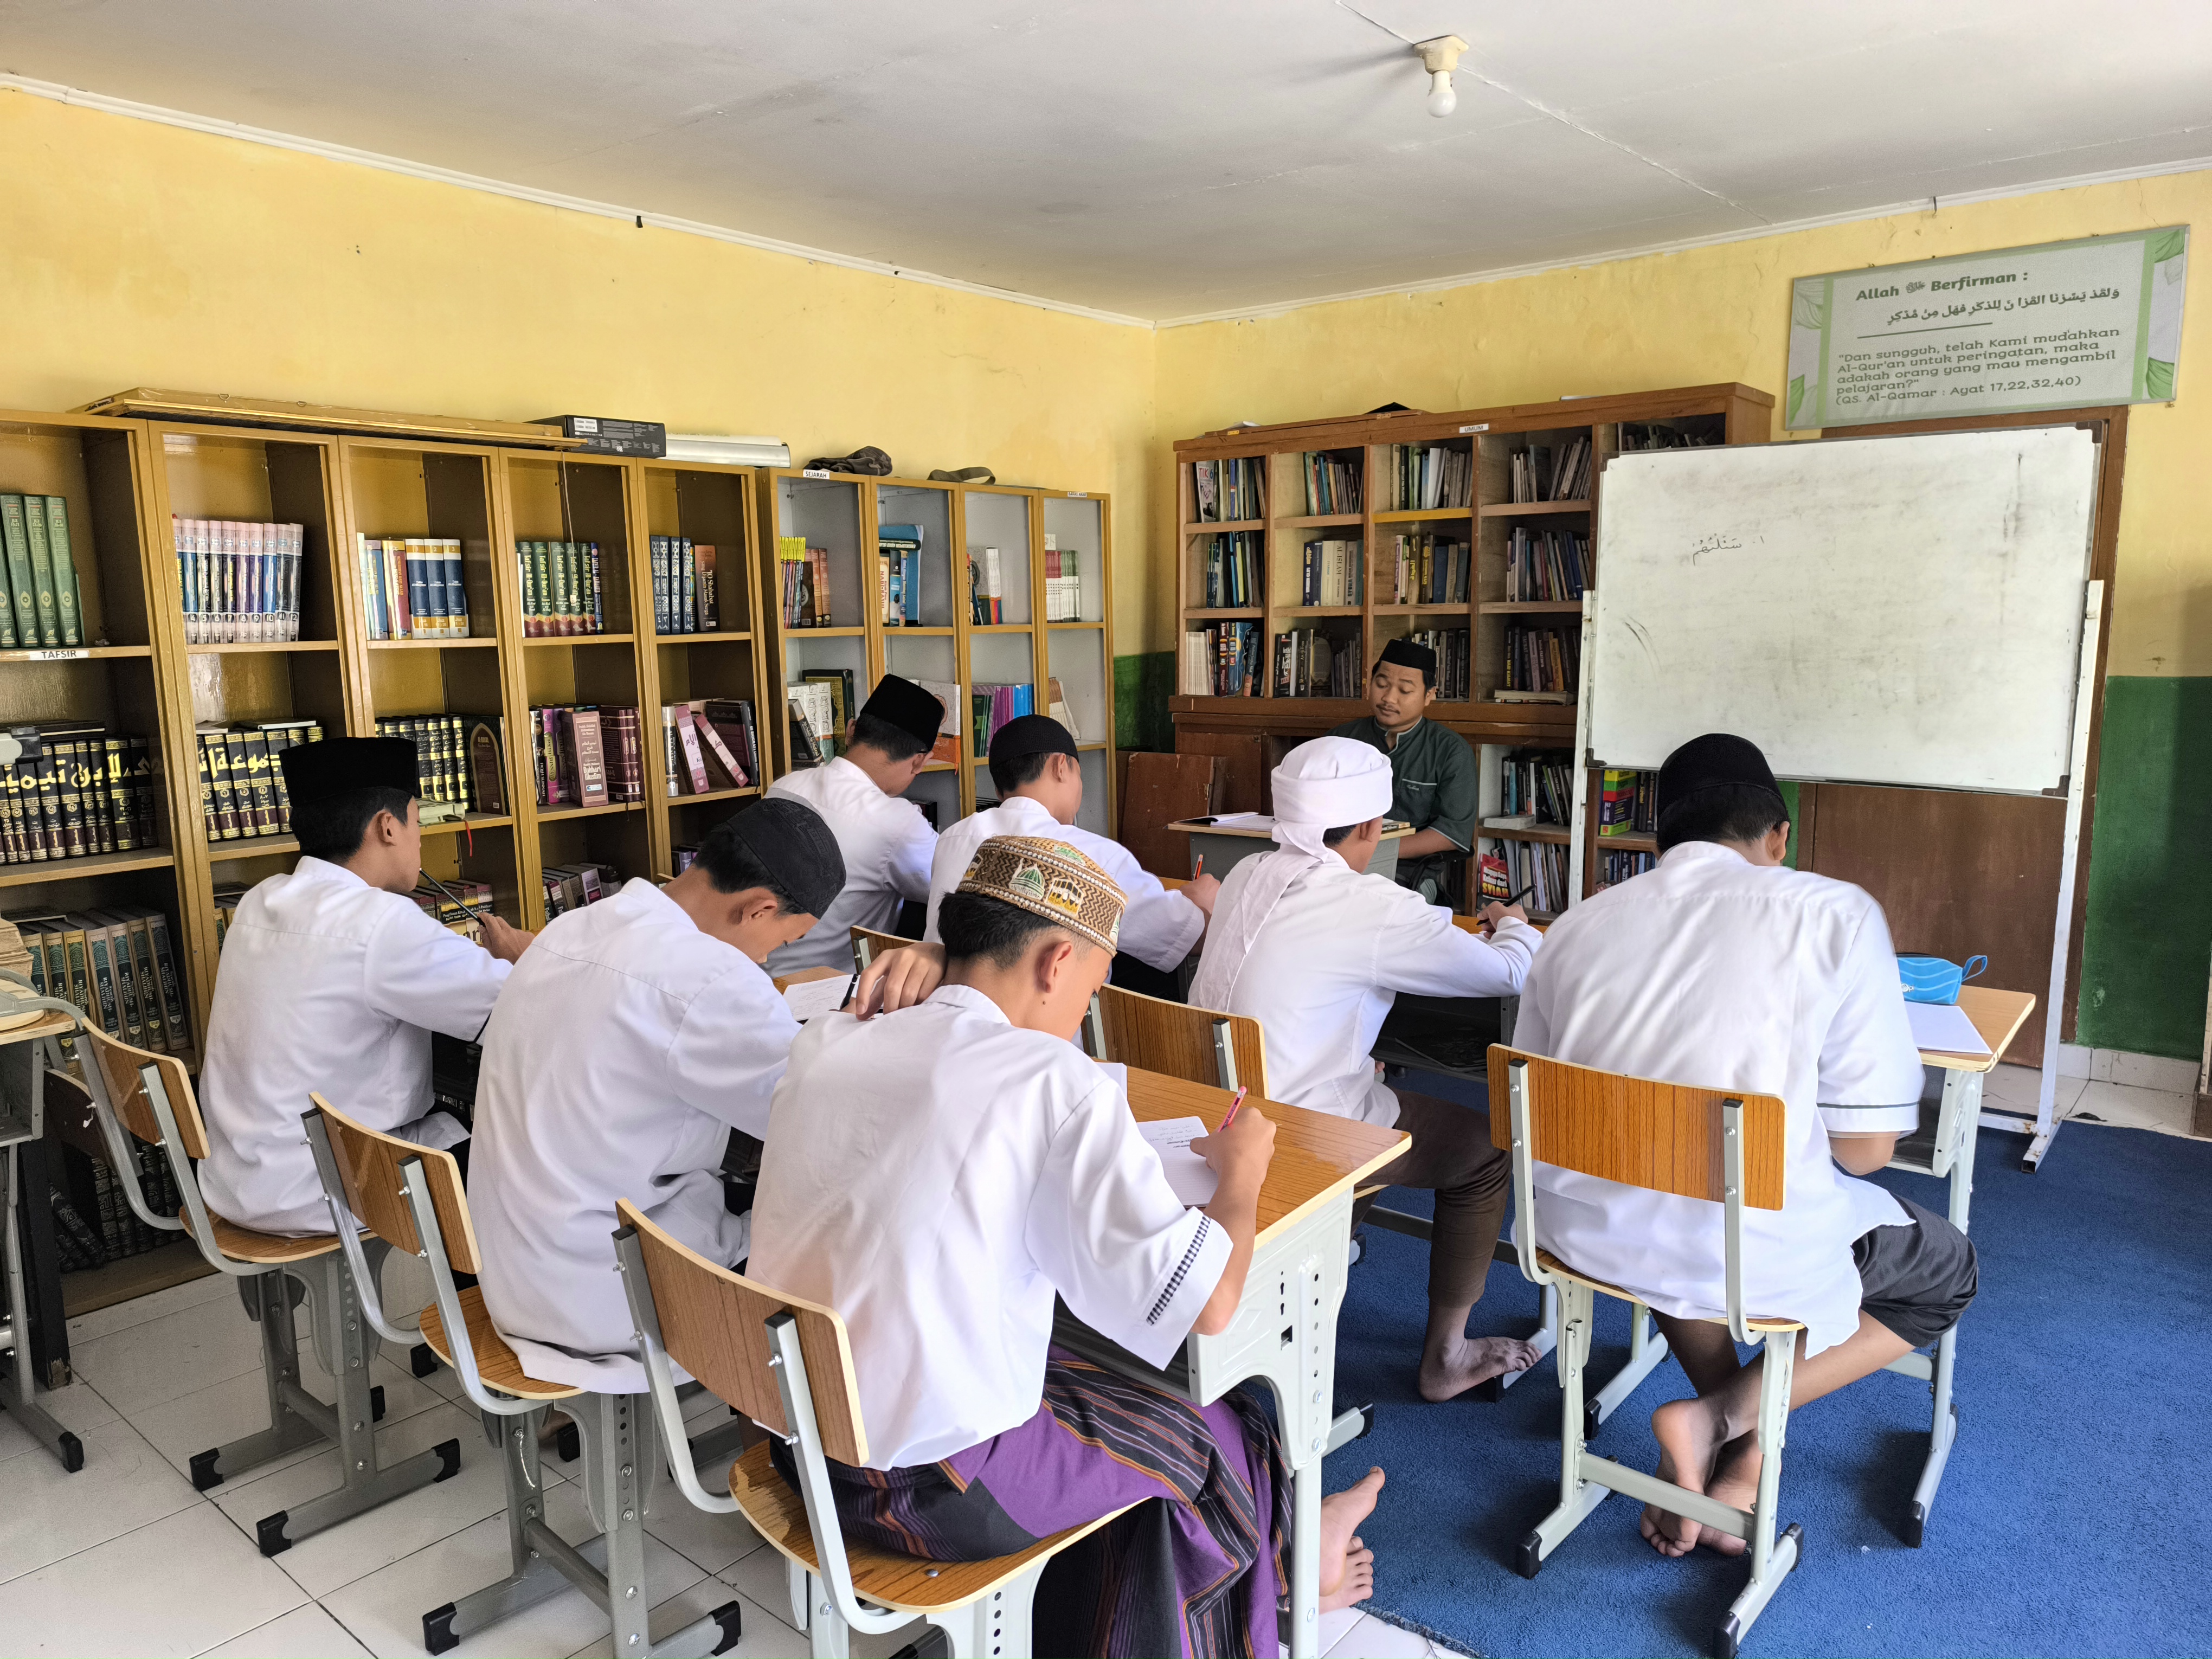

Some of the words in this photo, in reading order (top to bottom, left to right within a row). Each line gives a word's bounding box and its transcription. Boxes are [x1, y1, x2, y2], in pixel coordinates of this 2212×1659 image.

[1855, 286, 1899, 301] Allah
[1931, 273, 2016, 291] Berfirman
[1837, 361, 1905, 374] Al-Qur'an
[1910, 354, 1952, 366] untuk
[1957, 348, 2048, 364] peringatan,
[2054, 342, 2100, 353] maka
[1838, 353, 1871, 362] "Dan
[1875, 345, 1940, 359] sungguh,
[1945, 340, 1984, 352] telah
[1989, 336, 2027, 348] Kami
[2033, 329, 2119, 344] mudahkan
[1837, 371, 1890, 384] adakah
[1895, 368, 1939, 378] orang
[1944, 364, 1981, 377] yang
[1986, 360, 2020, 370] mau
[2025, 350, 2116, 366] mengambil
[1835, 395, 1862, 406] (QS.
[1866, 389, 1937, 402] Al-Qamar
[1950, 384, 1985, 396] Ayat
[1990, 375, 2081, 393] 17,22,32,40)
[1836, 379, 1919, 396] pelajaran?"
[1199, 468, 1208, 478] TIK
[41, 650, 77, 659] TAFSIR
[1482, 882, 1509, 898] SYIAH
